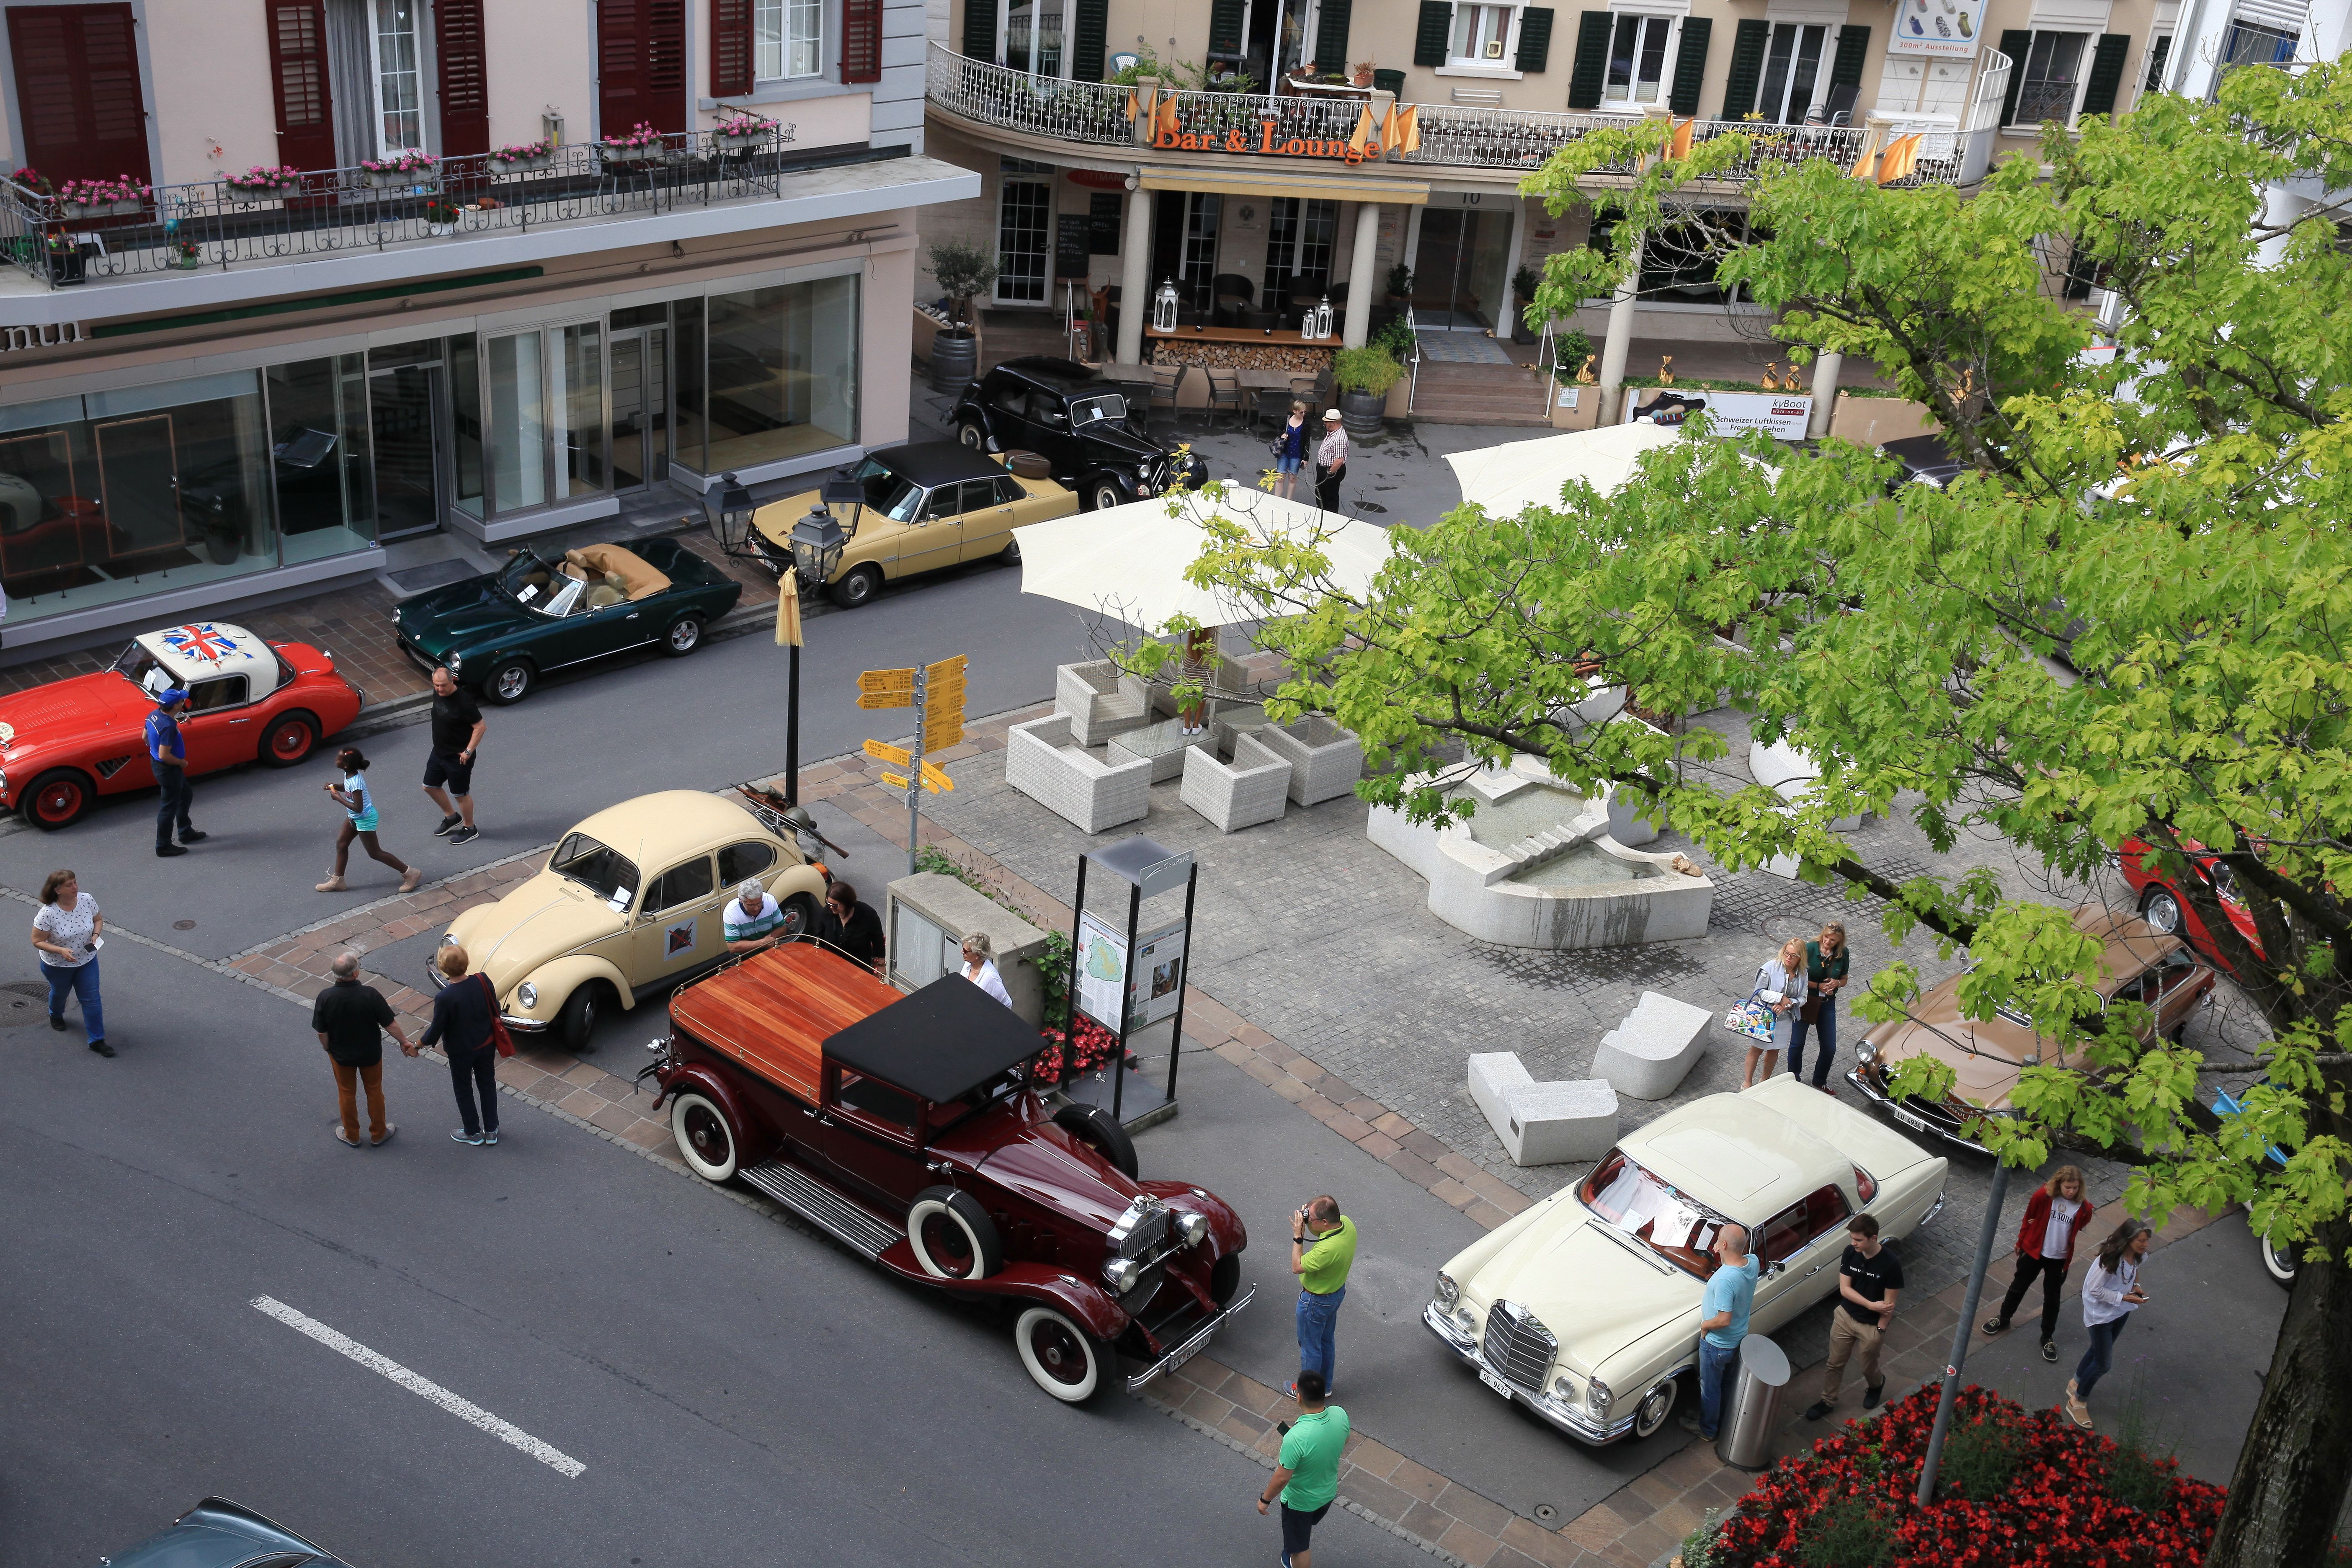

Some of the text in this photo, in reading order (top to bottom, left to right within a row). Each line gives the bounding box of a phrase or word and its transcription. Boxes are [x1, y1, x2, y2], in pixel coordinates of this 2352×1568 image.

[1925, 44, 1968, 53] Ausstellung
[1152, 116, 1380, 165] Bar & Lounge
[1463, 192, 1480, 204] 10
[0, 321, 84, 353] nth
[1772, 399, 1806, 410] kyBoot
[1907, 1117, 1921, 1129] 4934
[2057, 1212, 2072, 1225] SQUA
[1483, 1374, 1508, 1396] SG 9472
